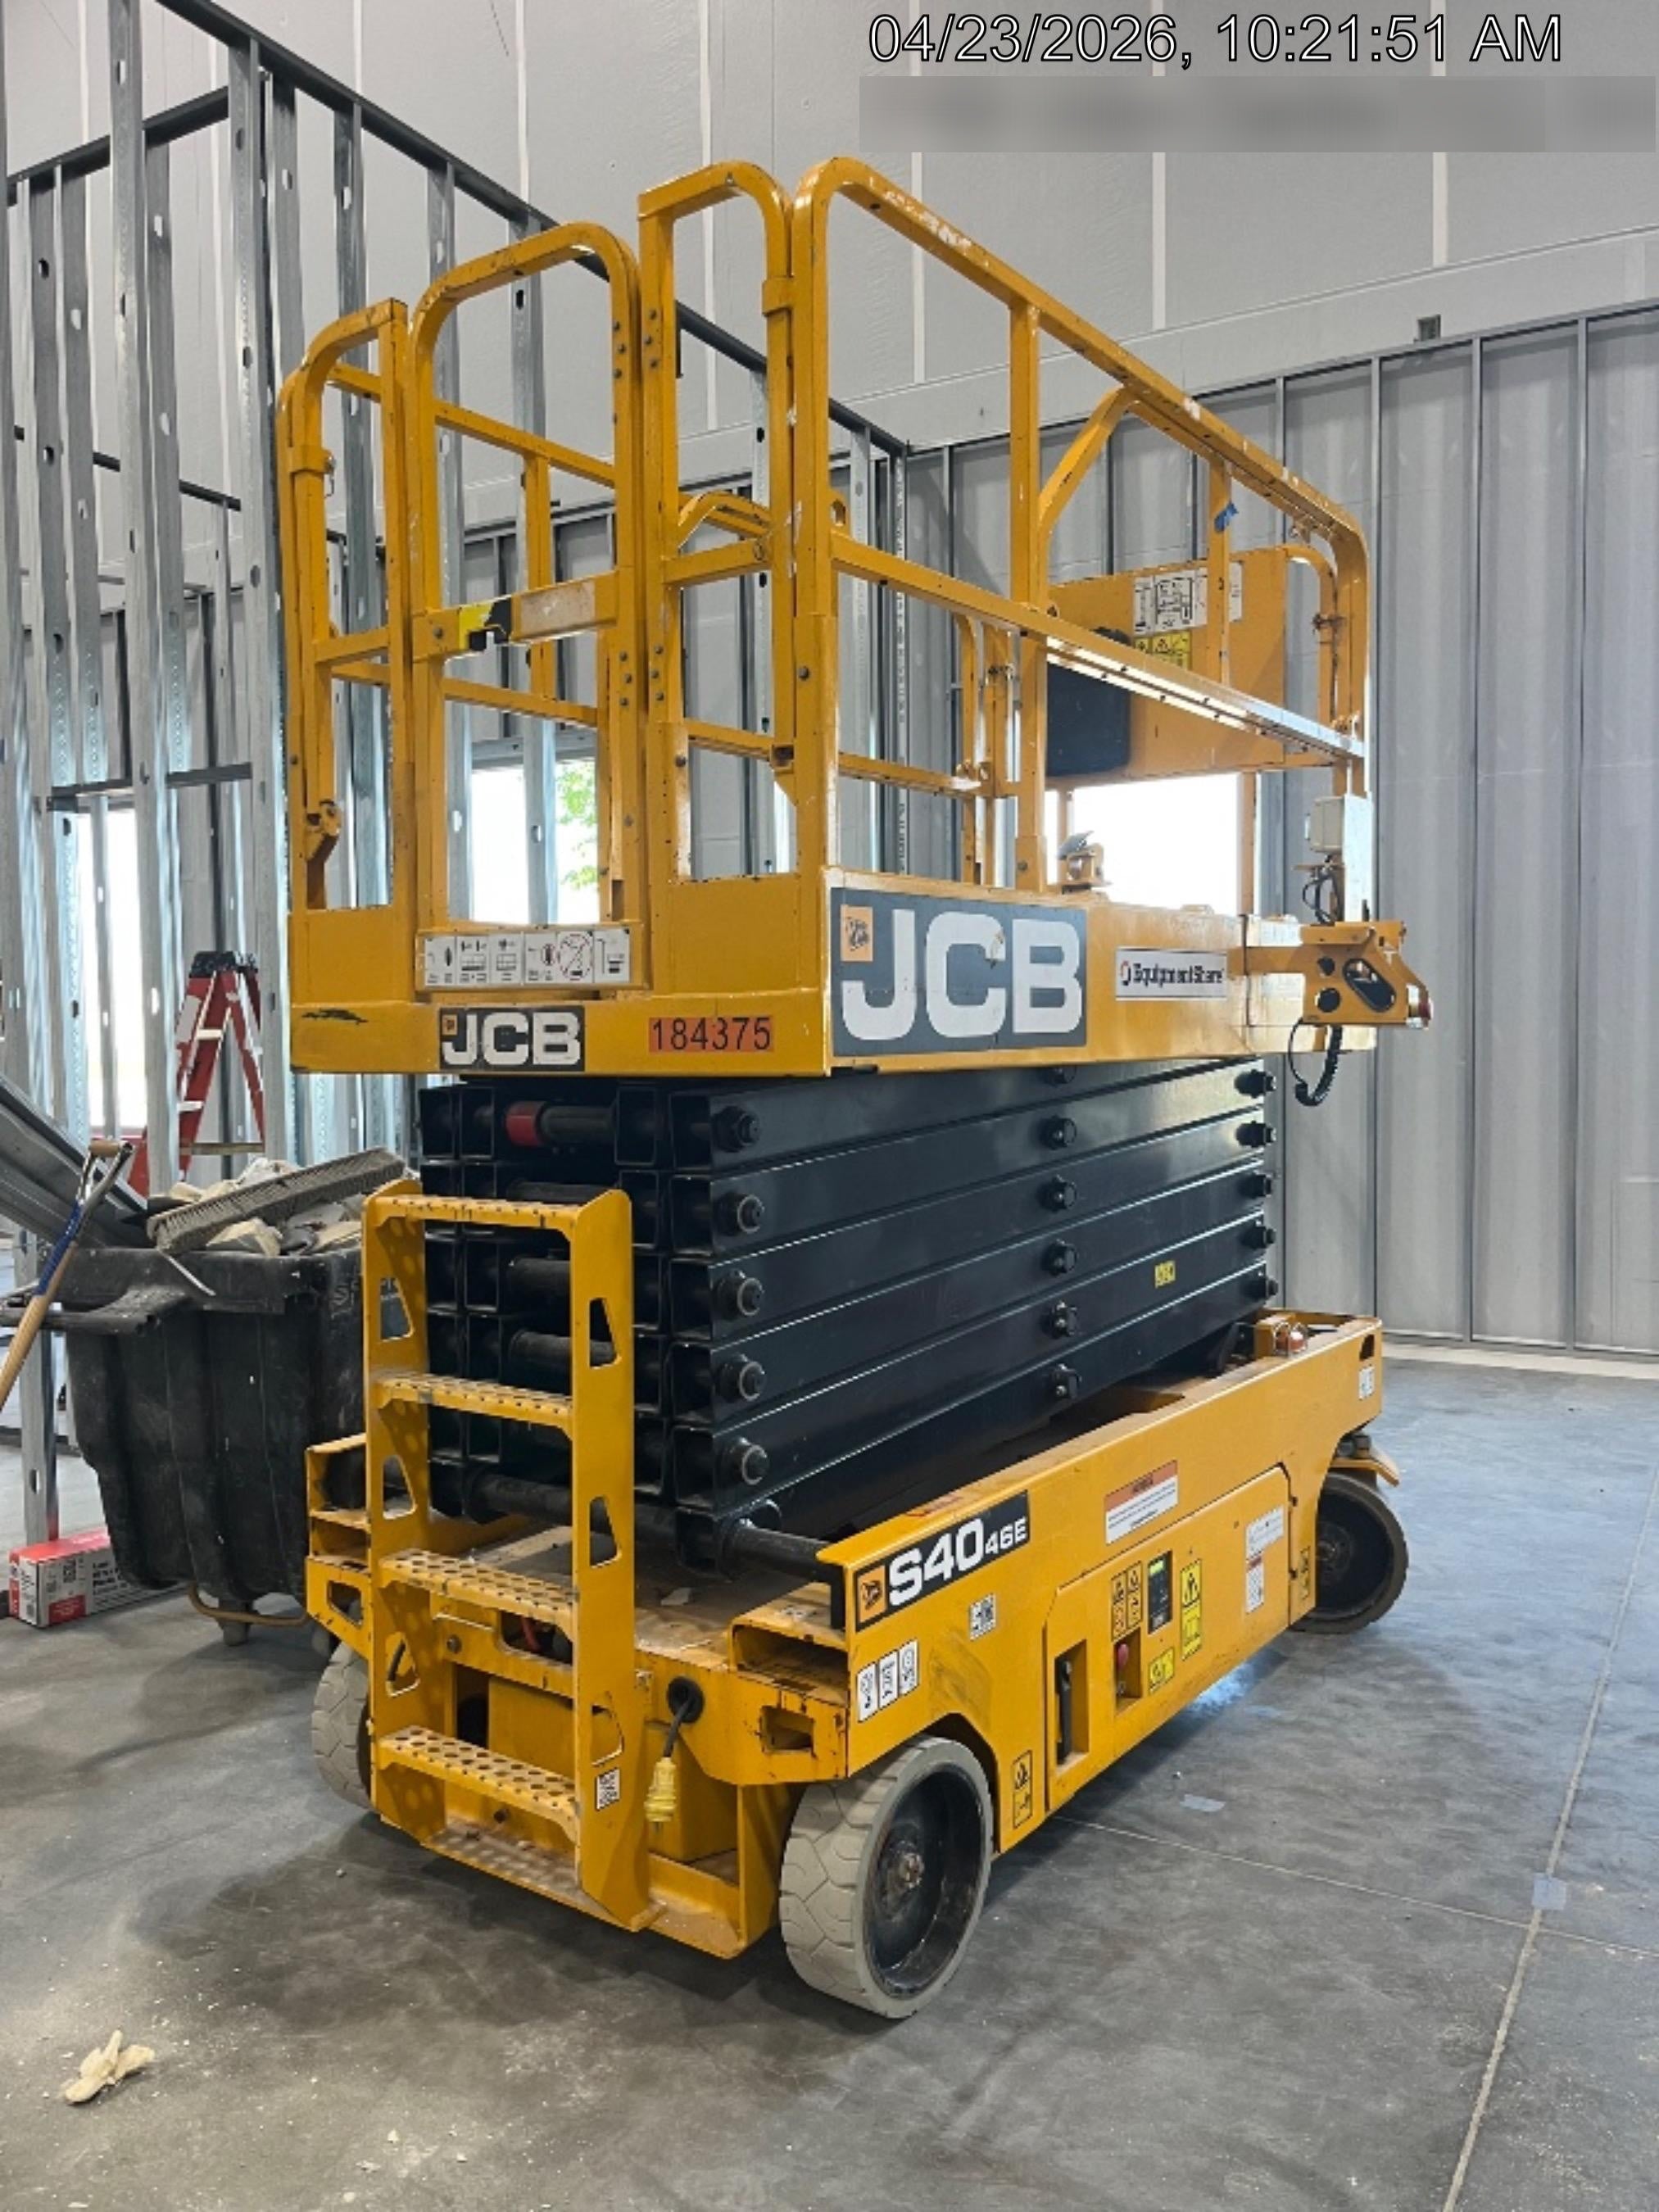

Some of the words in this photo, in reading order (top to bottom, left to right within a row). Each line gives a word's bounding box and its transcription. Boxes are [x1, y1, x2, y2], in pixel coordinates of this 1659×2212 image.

[841, 909, 1082, 1040] JCB
[1132, 962, 1223, 989] EquipmentShare
[442, 1012, 581, 1066] JCB
[653, 1016, 771, 1051] 184375
